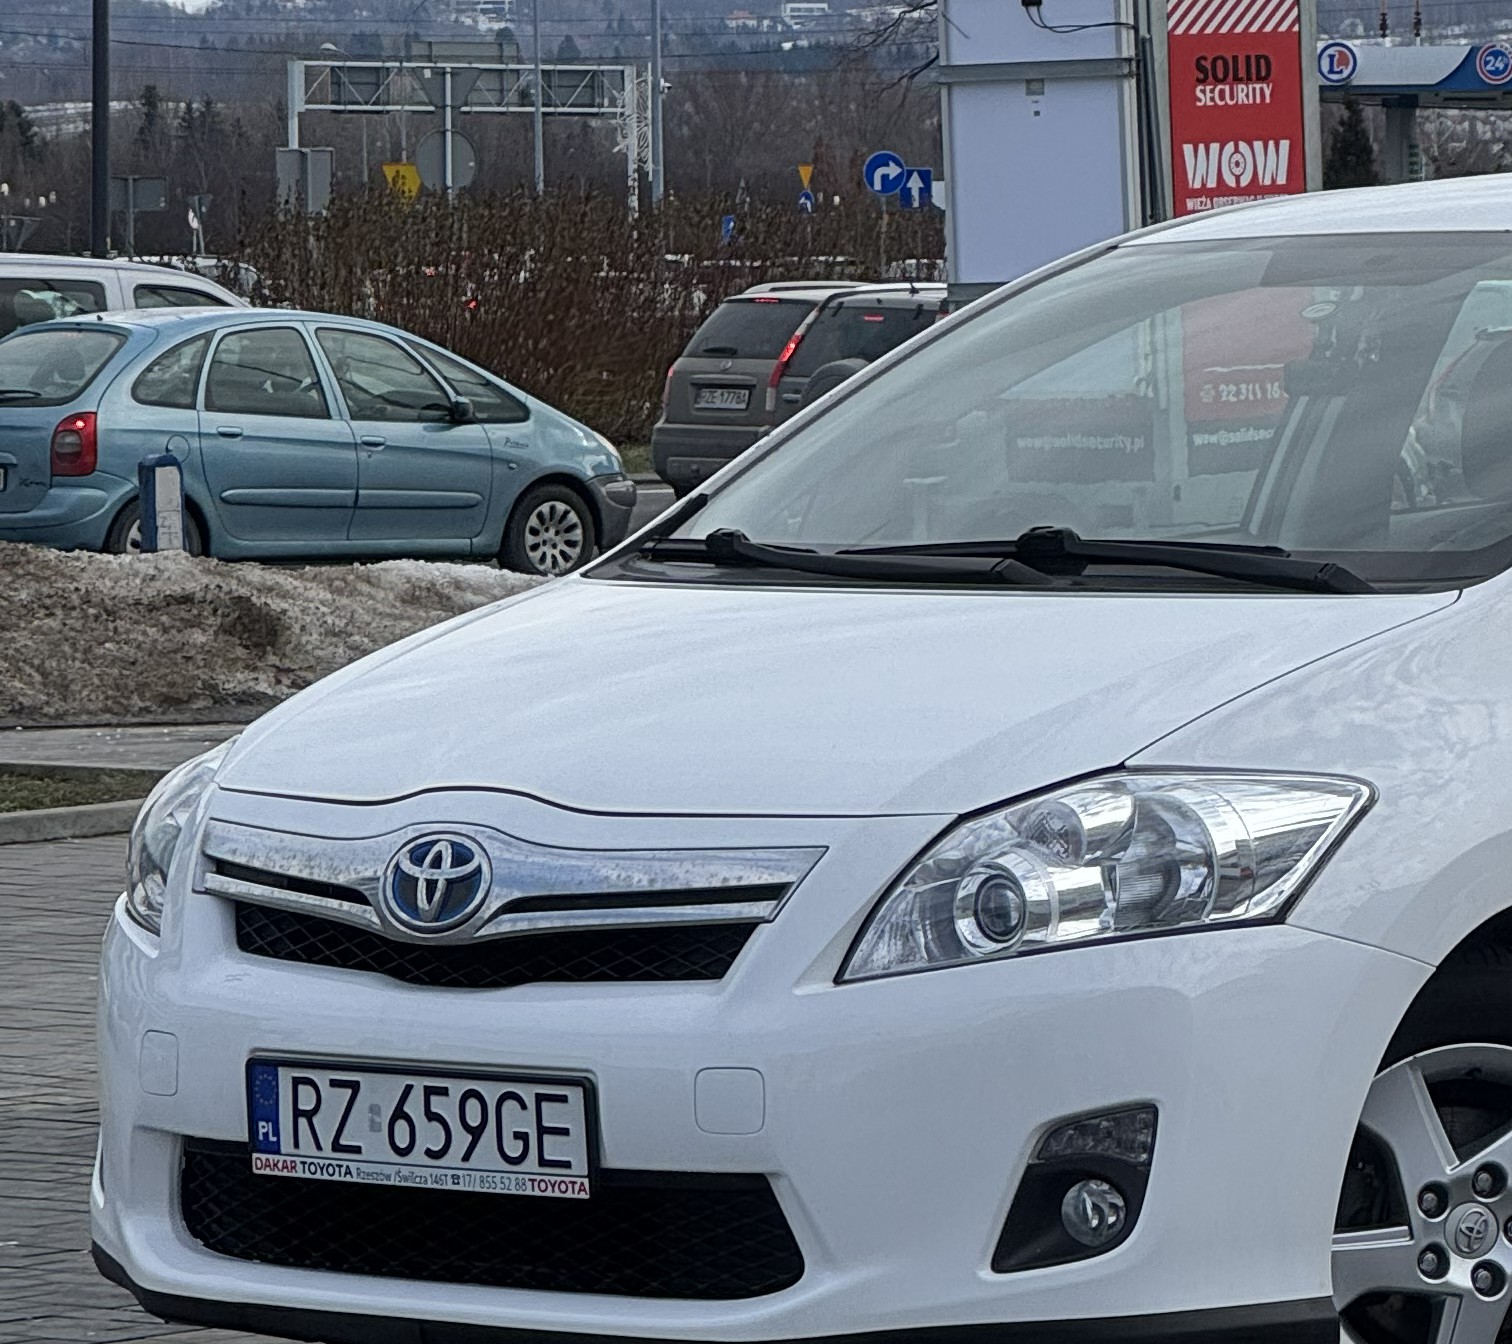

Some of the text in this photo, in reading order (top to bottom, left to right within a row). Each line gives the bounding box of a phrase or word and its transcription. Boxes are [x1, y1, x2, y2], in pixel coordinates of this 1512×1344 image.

[1195, 54, 1272, 84] SOLID
[1195, 82, 1273, 106] SECURITY
[1182, 139, 1290, 189] WOW
[258, 1121, 277, 1143] PL
[291, 1076, 572, 1169] RZ 659GE
[255, 1157, 297, 1174] DAKAR
[300, 1161, 353, 1179] TOYOTA
[480, 1175, 497, 1191] 855
[500, 1176, 512, 1192] 52
[515, 1177, 527, 1192] 88
[528, 1177, 588, 1196] TOYOTA
